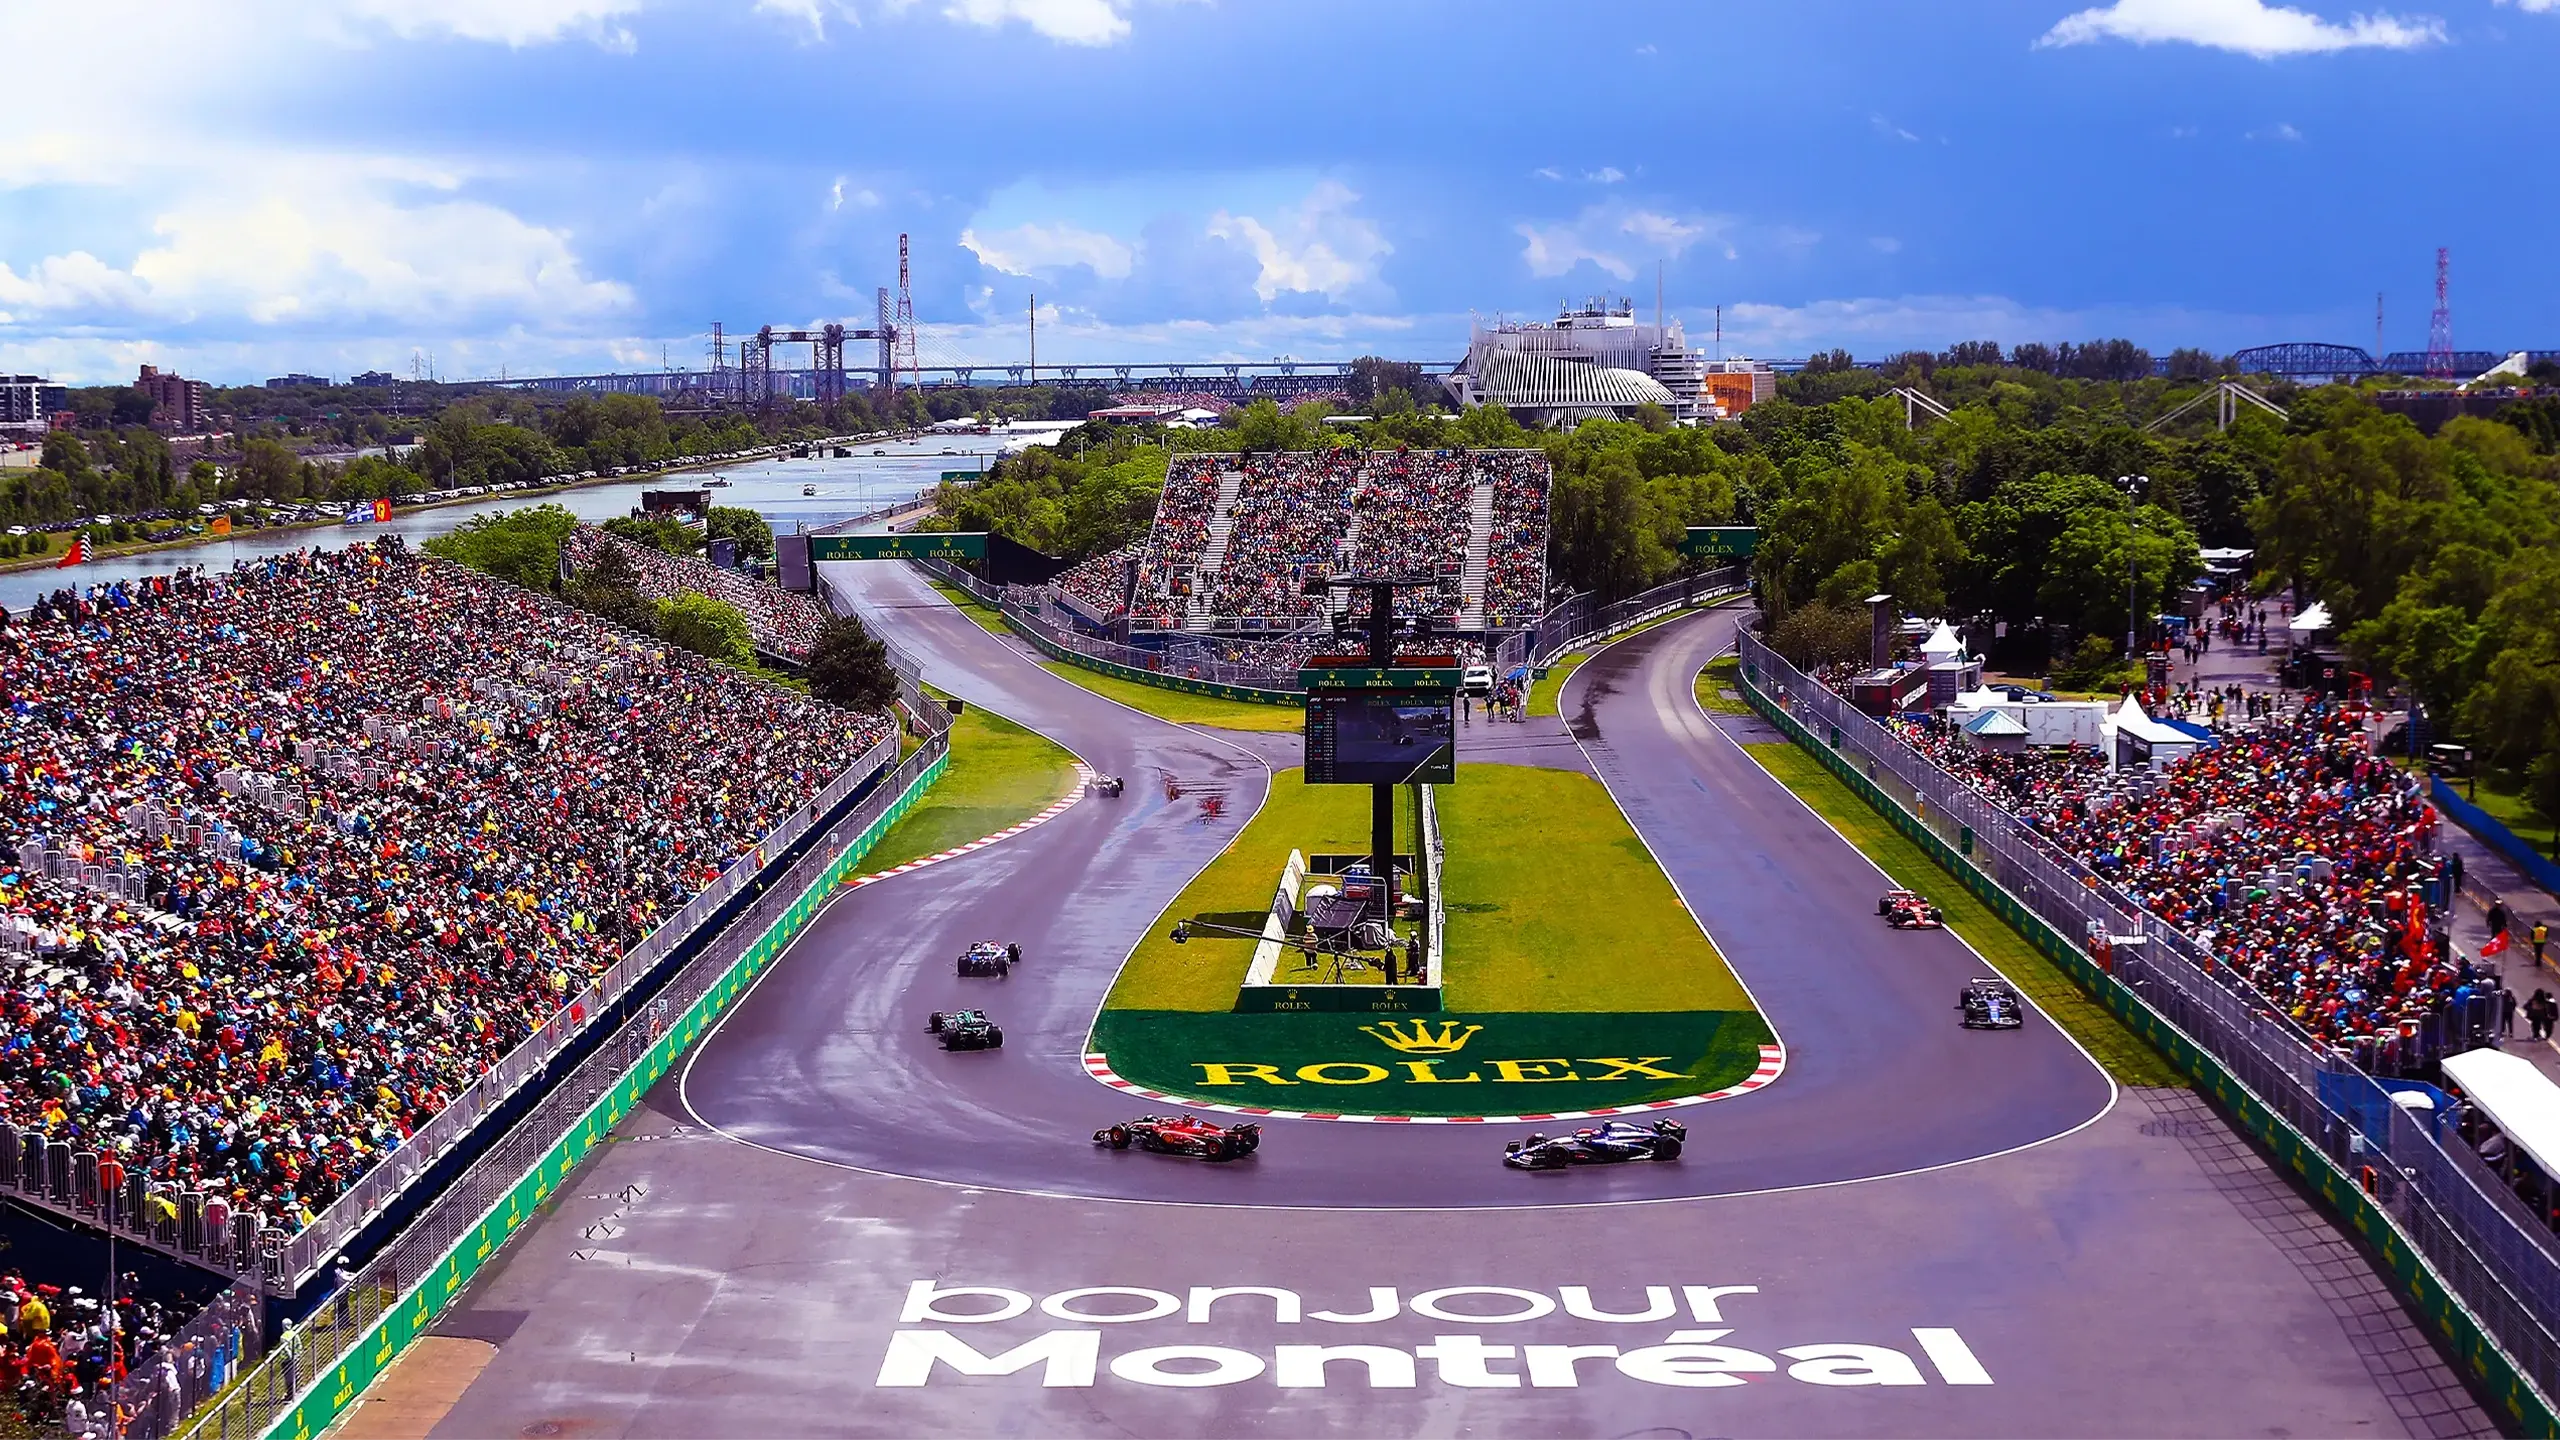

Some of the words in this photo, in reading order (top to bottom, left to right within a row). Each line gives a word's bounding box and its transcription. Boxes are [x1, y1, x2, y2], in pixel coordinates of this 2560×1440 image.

[826, 551, 862, 559] ROLEX
[878, 550, 913, 558] ROLEX
[930, 549, 964, 558] ROLEX
[1695, 545, 1734, 553] ROLEX
[1372, 1002, 1408, 1010] ROLEX
[1191, 1056, 1697, 1086] ROLEX
[446, 1271, 460, 1293] ROLEX
[898, 1280, 1759, 1323] bonjour
[413, 1306, 428, 1329] ROLEX
[376, 1341, 392, 1367] ROLEX
[876, 1328, 1994, 1388] Montréal
[334, 1381, 353, 1409] ROLEX
